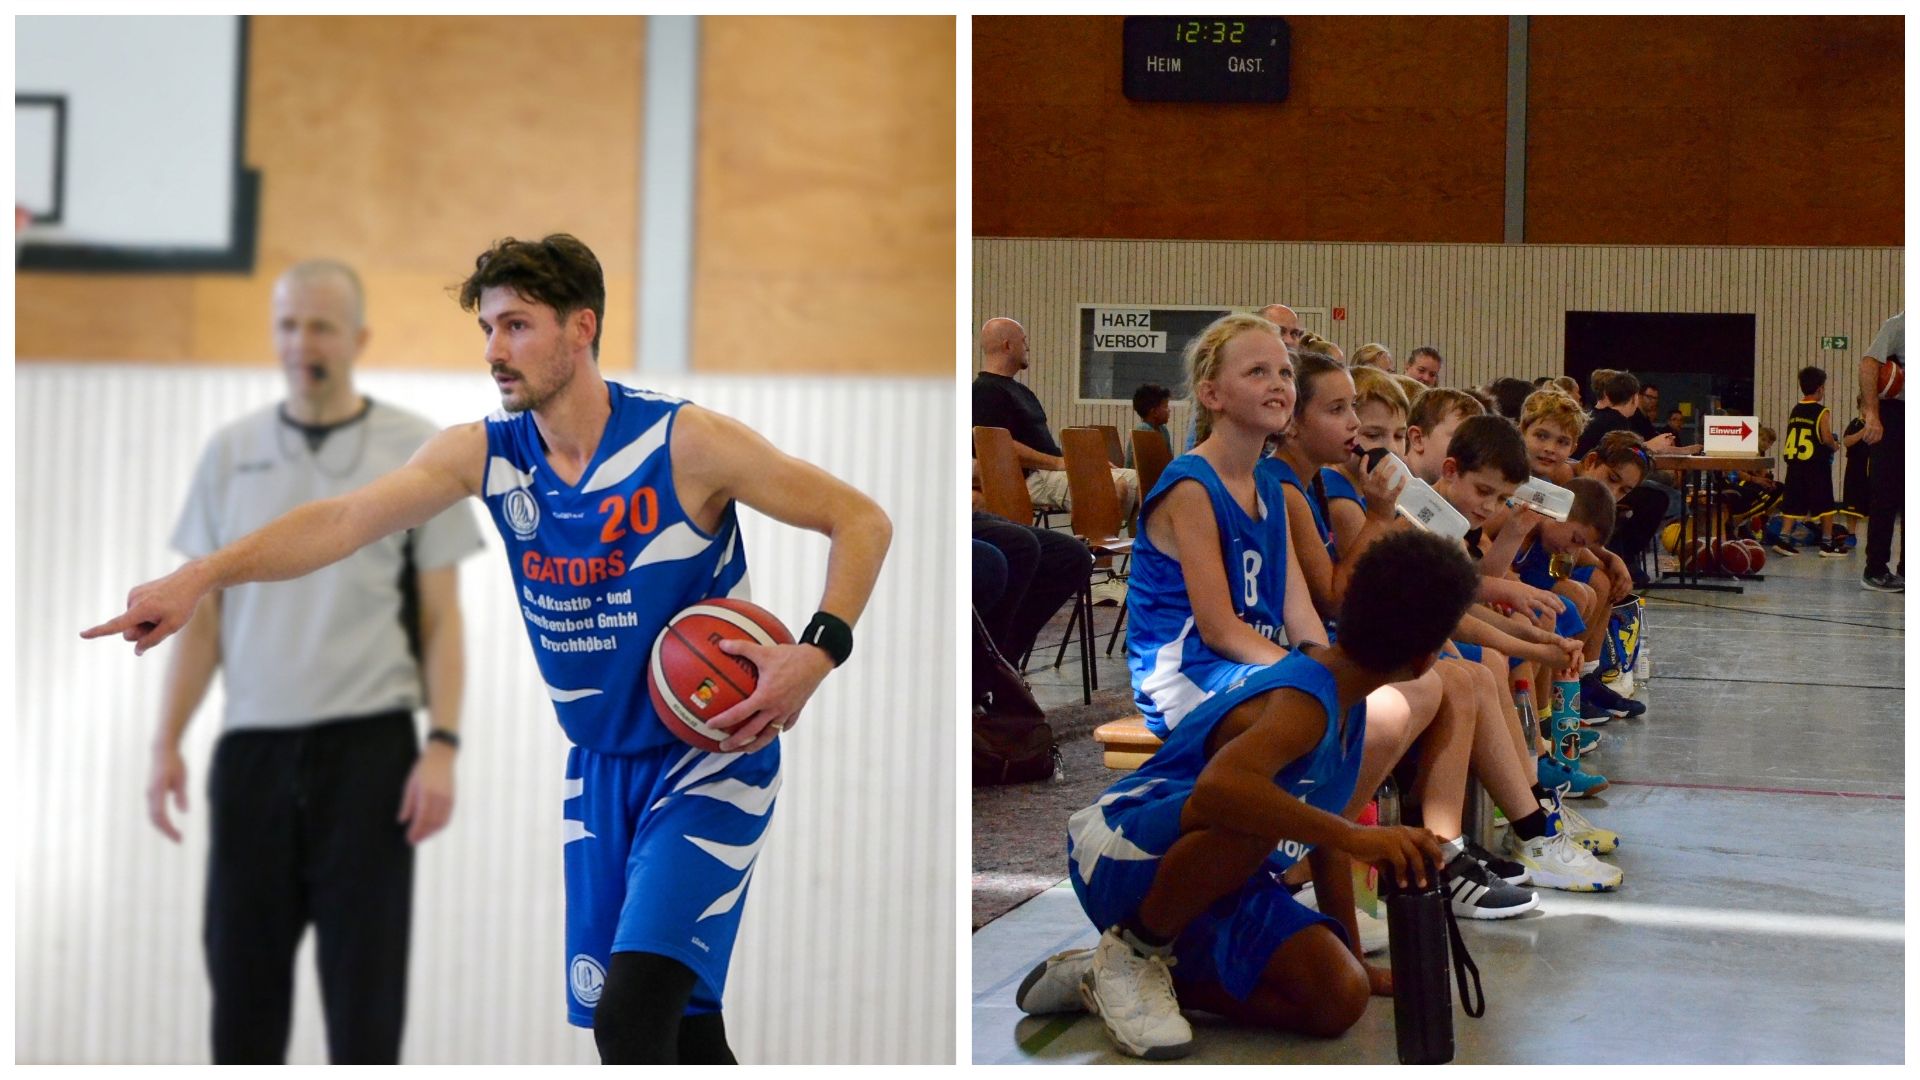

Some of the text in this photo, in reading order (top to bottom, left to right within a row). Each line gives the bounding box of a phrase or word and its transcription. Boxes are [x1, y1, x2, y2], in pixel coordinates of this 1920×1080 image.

[1176, 22, 1245, 43] 12:32
[1102, 313, 1149, 327] HARZ
[1094, 334, 1159, 348] VERBOT
[1710, 427, 1742, 435] Einwurf
[1784, 427, 1814, 460] 45
[599, 486, 660, 544] 20
[523, 549, 626, 587] GATORS
